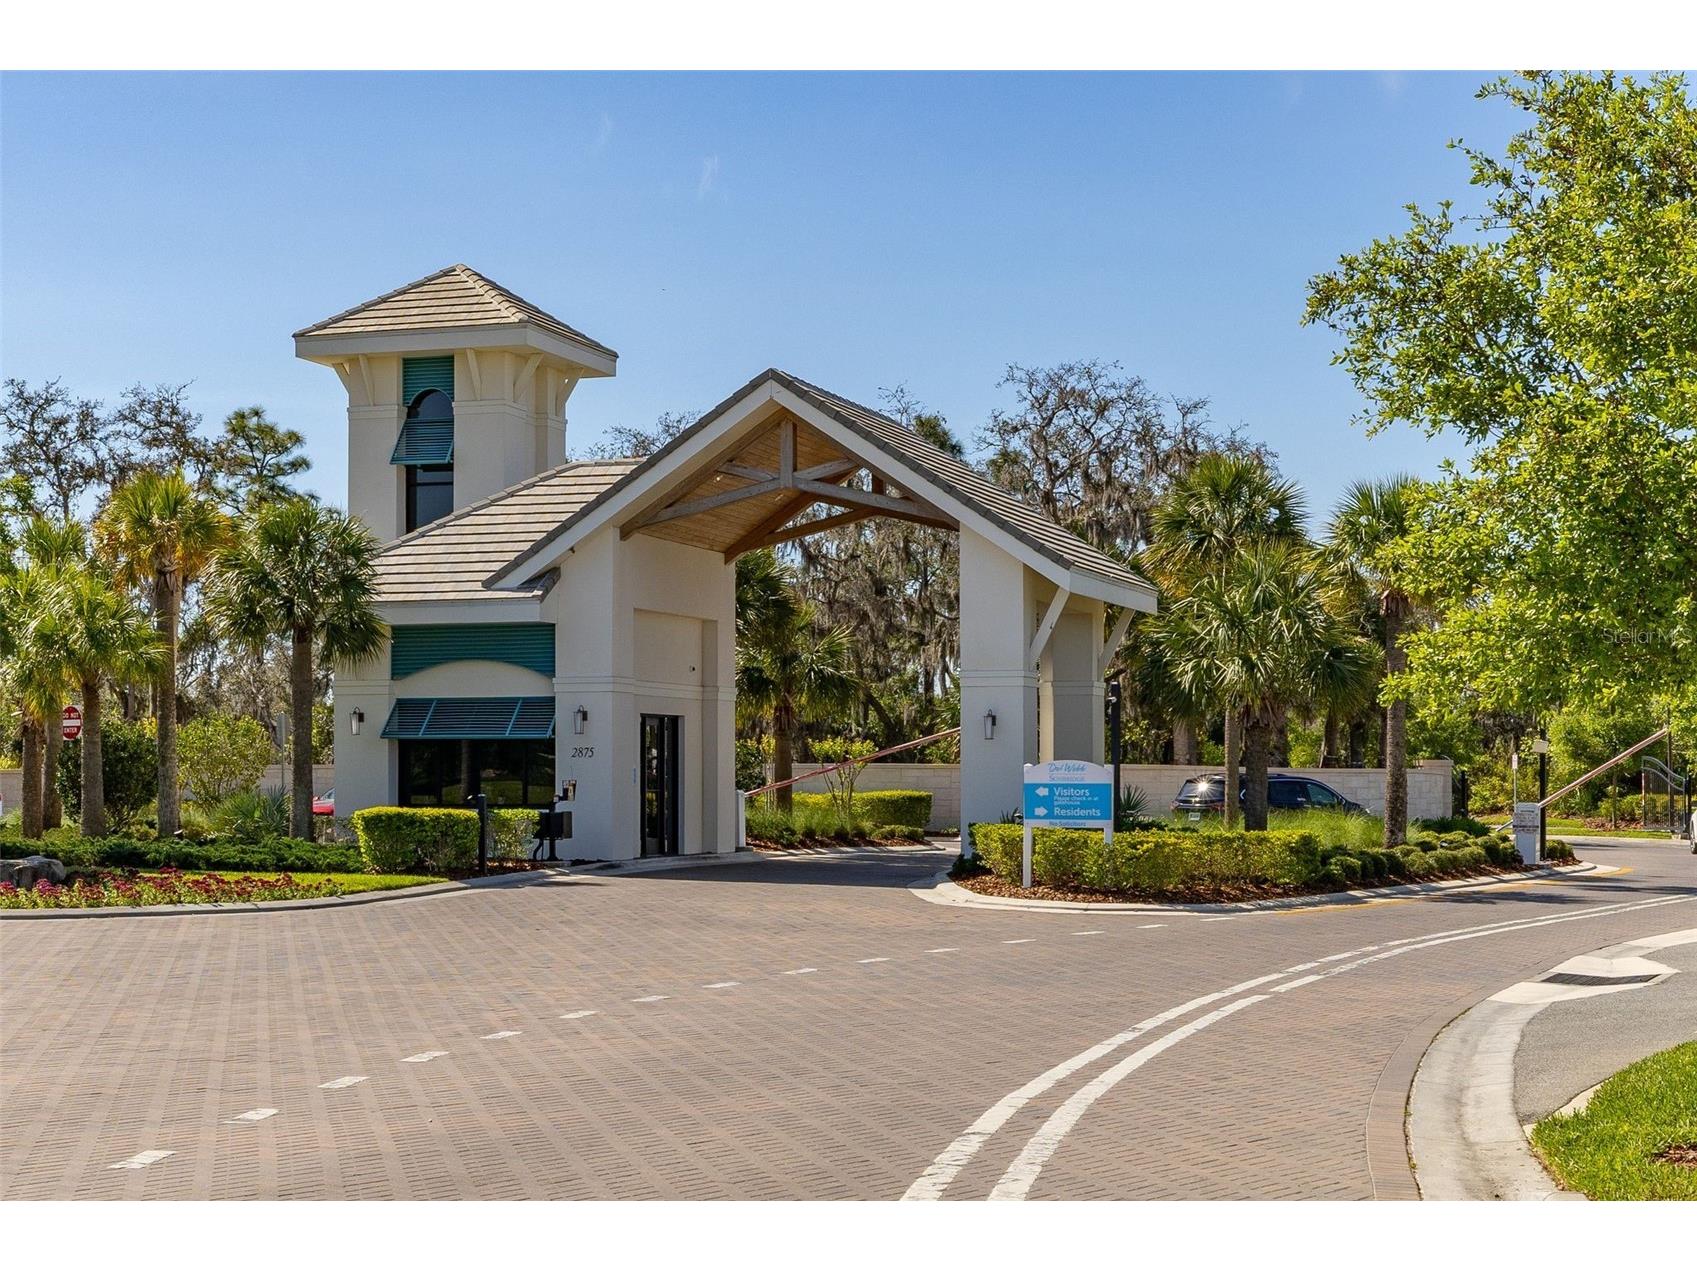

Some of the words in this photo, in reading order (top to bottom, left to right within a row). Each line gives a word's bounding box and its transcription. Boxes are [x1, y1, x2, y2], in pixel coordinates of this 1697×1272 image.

[571, 746, 595, 758] 2875
[1053, 786, 1090, 796] Visitors
[1053, 807, 1101, 817] Residents
